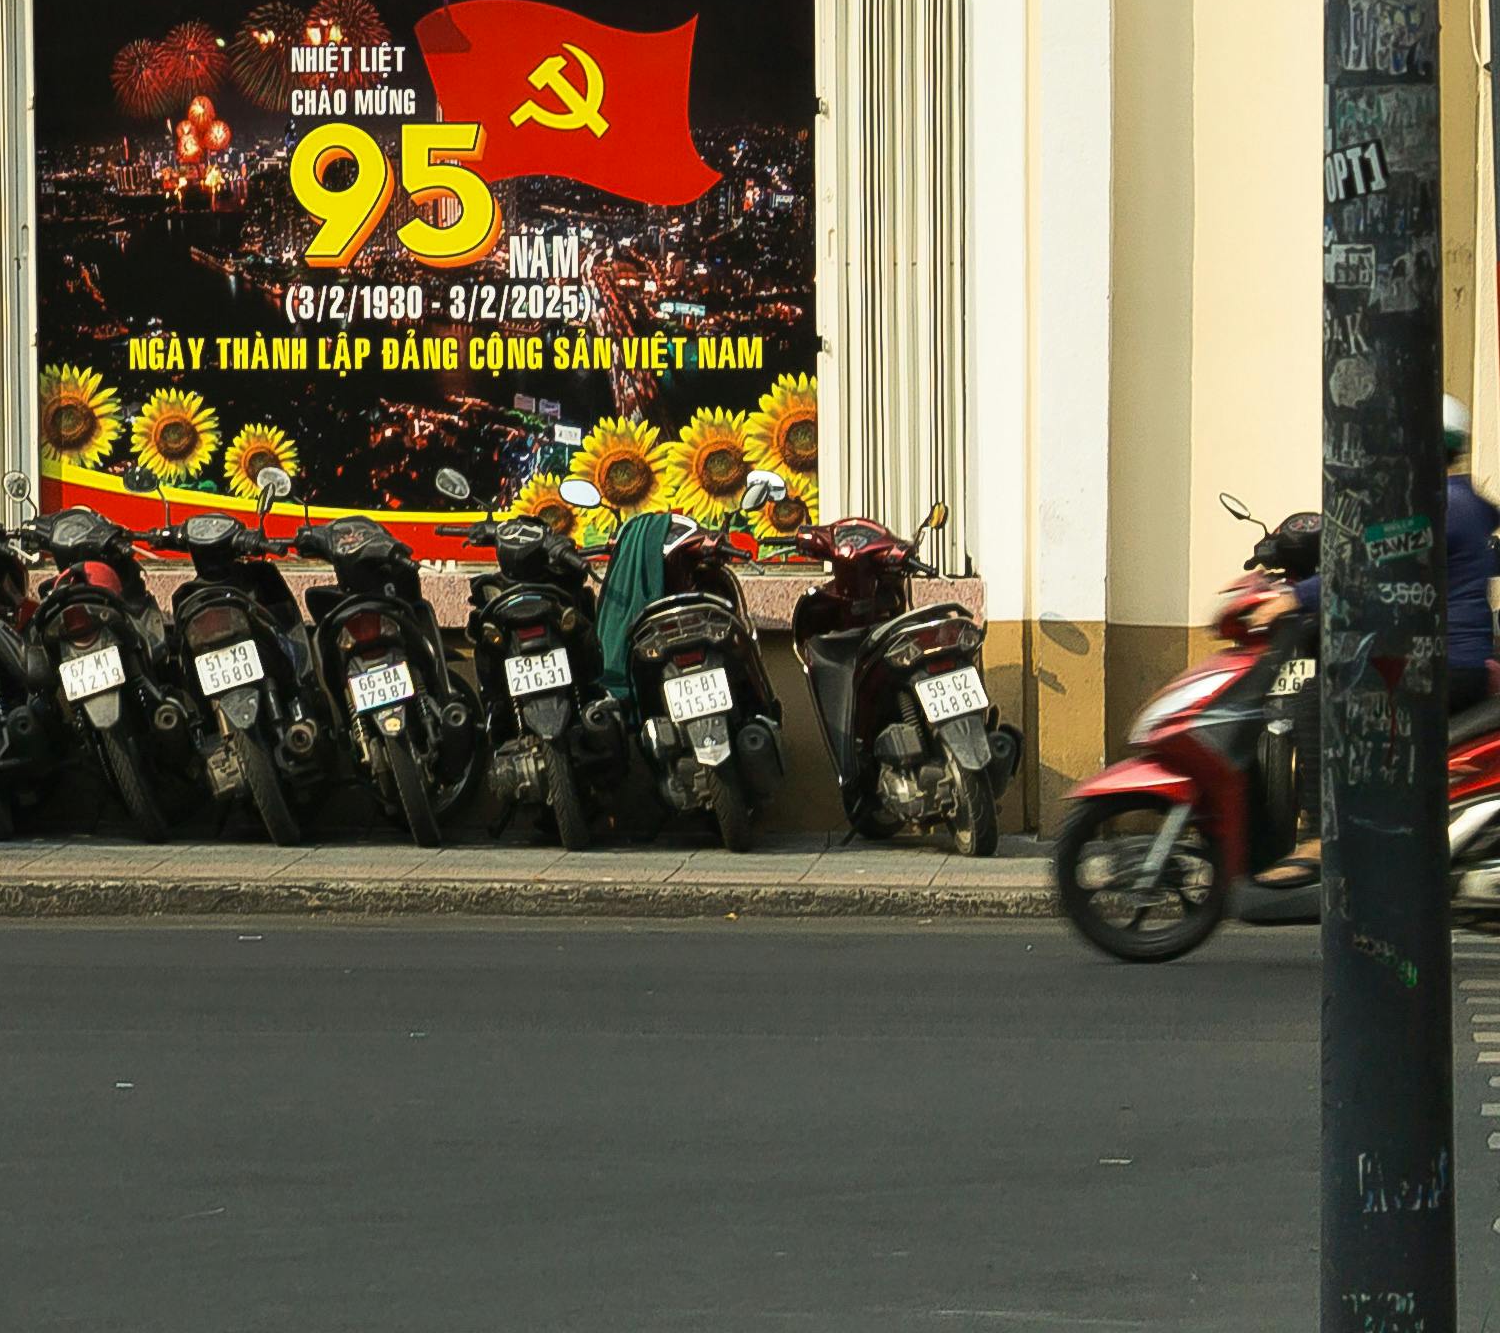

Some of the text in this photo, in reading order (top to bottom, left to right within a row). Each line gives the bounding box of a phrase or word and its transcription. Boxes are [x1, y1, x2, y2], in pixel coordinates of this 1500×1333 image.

[290, 42, 406, 78] NHIỆT LIỆT
[291, 85, 416, 116] CHÀO MỪNG
[290, 123, 580, 279] 95 NĂM
[284, 284, 424, 322] (3/2/1930
[448, 284, 592, 322] 3/2/2025)
[129, 328, 763, 377] NGÀY THÀNH LẬP ĐẢNG CỘNG SẢN VIỆT NAM
[210, 663, 254, 689] 5680
[515, 652, 559, 675] 59-E1
[359, 681, 408, 708] 179.87
[513, 668, 566, 693] 216.31
[673, 692, 729, 719] 315.53
